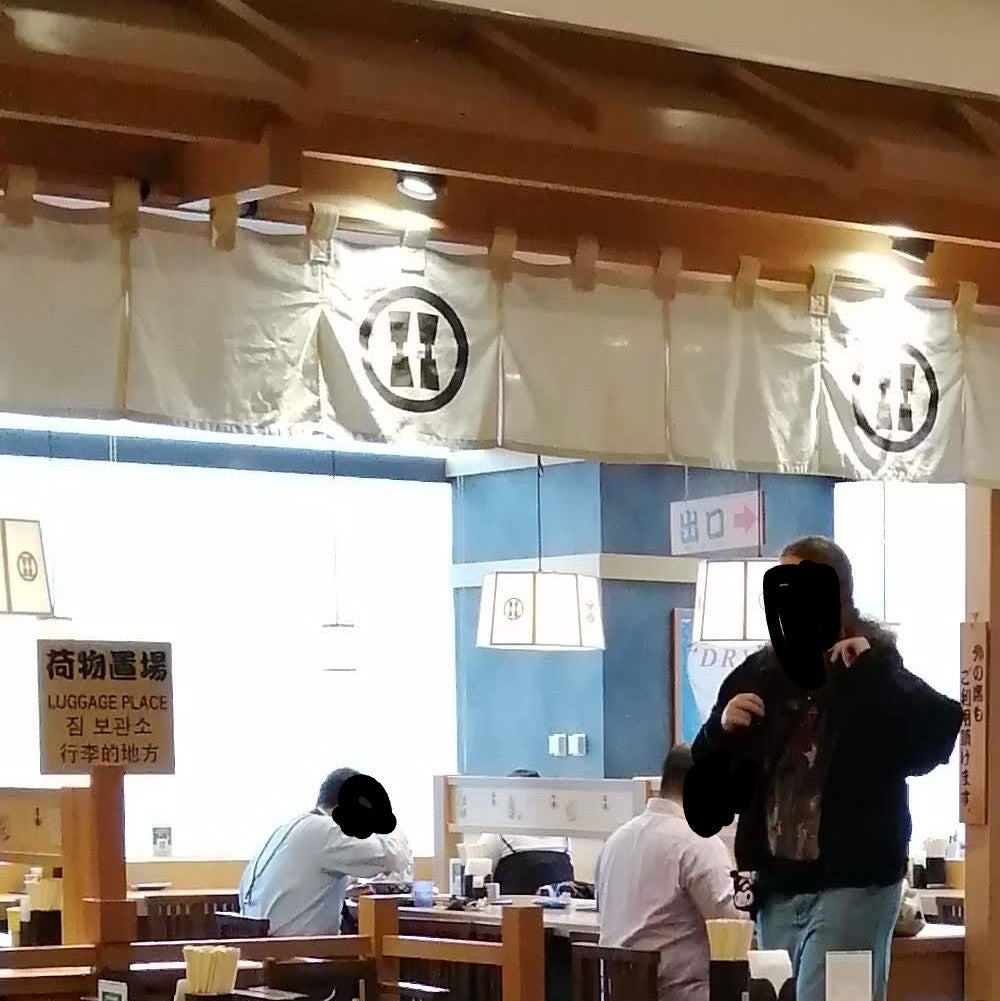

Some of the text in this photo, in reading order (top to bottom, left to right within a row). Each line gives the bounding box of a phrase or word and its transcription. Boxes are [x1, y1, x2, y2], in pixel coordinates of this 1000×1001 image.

[679, 508, 725, 544] 出口
[46, 648, 168, 682] 荷物置場
[47, 694, 168, 710] LUGGAGE PLACE
[66, 716, 153, 737] 짐 보관소
[59, 743, 160, 764] 行李的地方
